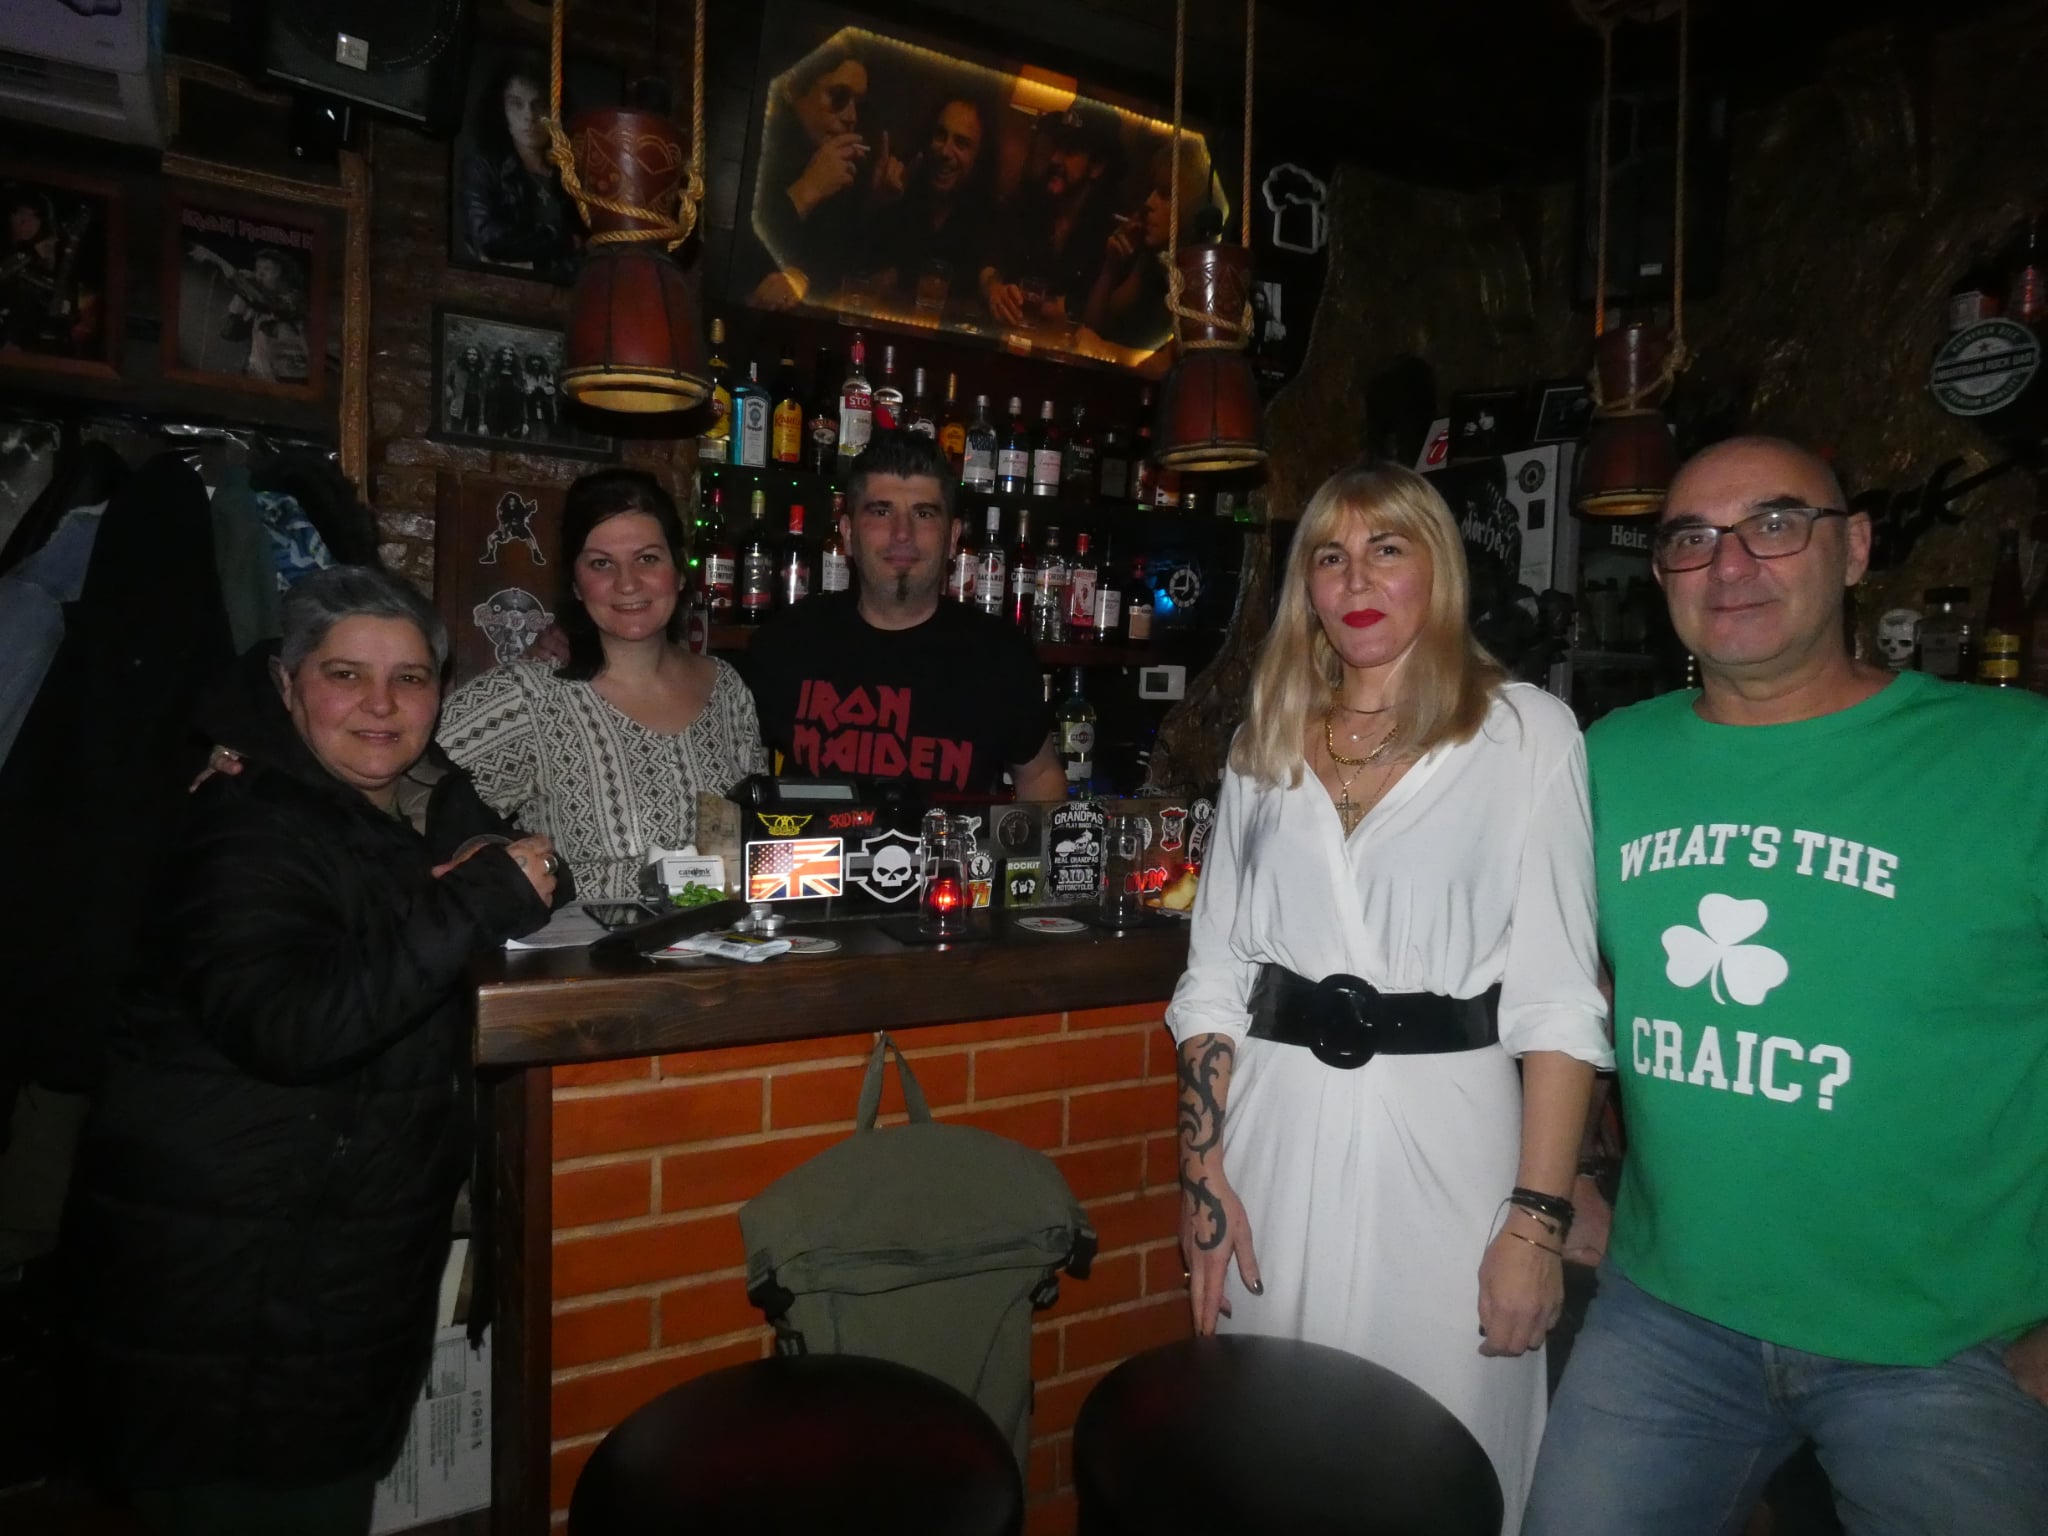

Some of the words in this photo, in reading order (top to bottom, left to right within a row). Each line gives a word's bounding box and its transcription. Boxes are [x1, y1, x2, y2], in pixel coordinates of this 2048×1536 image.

[795, 680, 912, 742] IRON
[793, 724, 973, 792] MAIDEN
[1070, 802, 1090, 811] SOME
[828, 812, 852, 829] SKID
[1054, 811, 1104, 826] GRANDPAS
[1054, 856, 1069, 864] REAL
[1070, 855, 1100, 864] GRANDPAS
[1620, 823, 1782, 882] WHAT'S
[1792, 828, 1899, 899] THE
[1057, 868, 1094, 884] RIDE
[1055, 884, 1094, 892] MOTORCYCLES
[1632, 1016, 1851, 1111] CRAIC?
